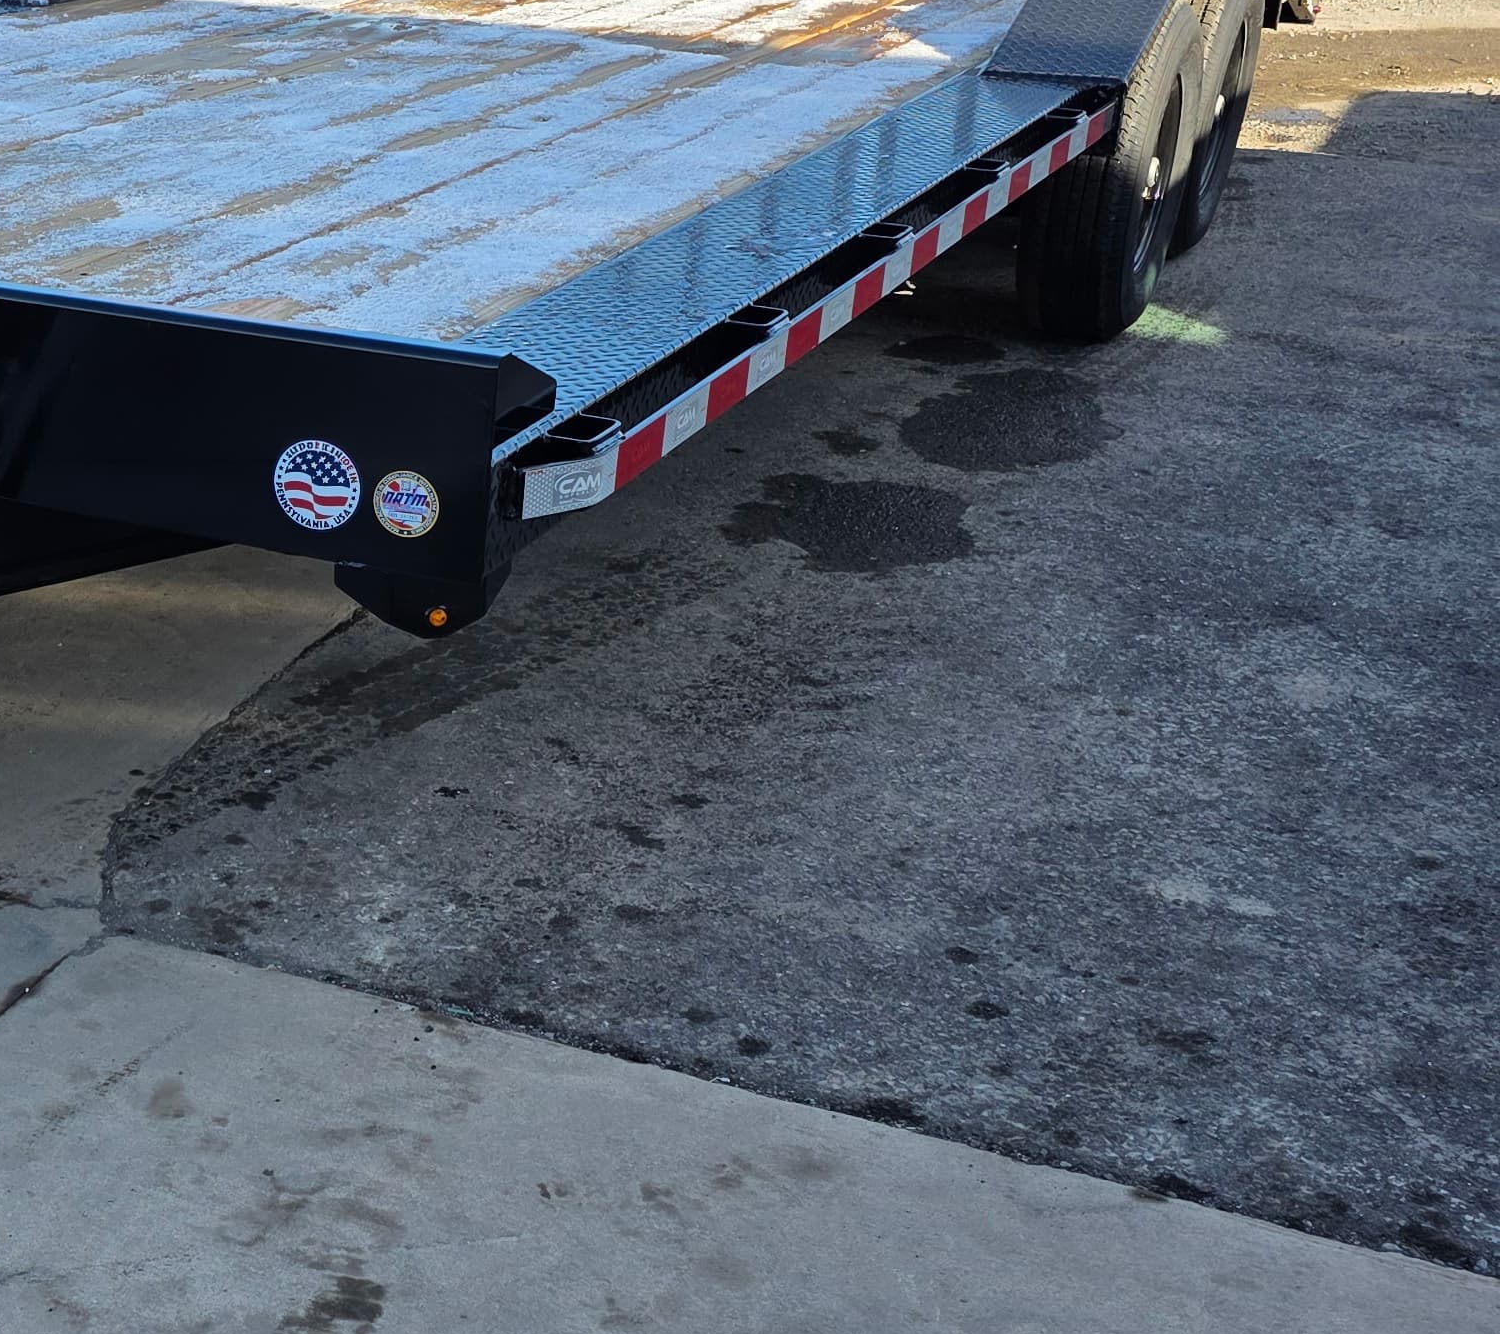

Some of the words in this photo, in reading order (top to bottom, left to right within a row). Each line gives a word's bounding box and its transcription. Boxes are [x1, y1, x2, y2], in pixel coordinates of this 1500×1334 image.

[559, 472, 601, 495] CAM
[275, 481, 334, 529] PENNSYLVANIA,
[332, 509, 352, 525] USA
